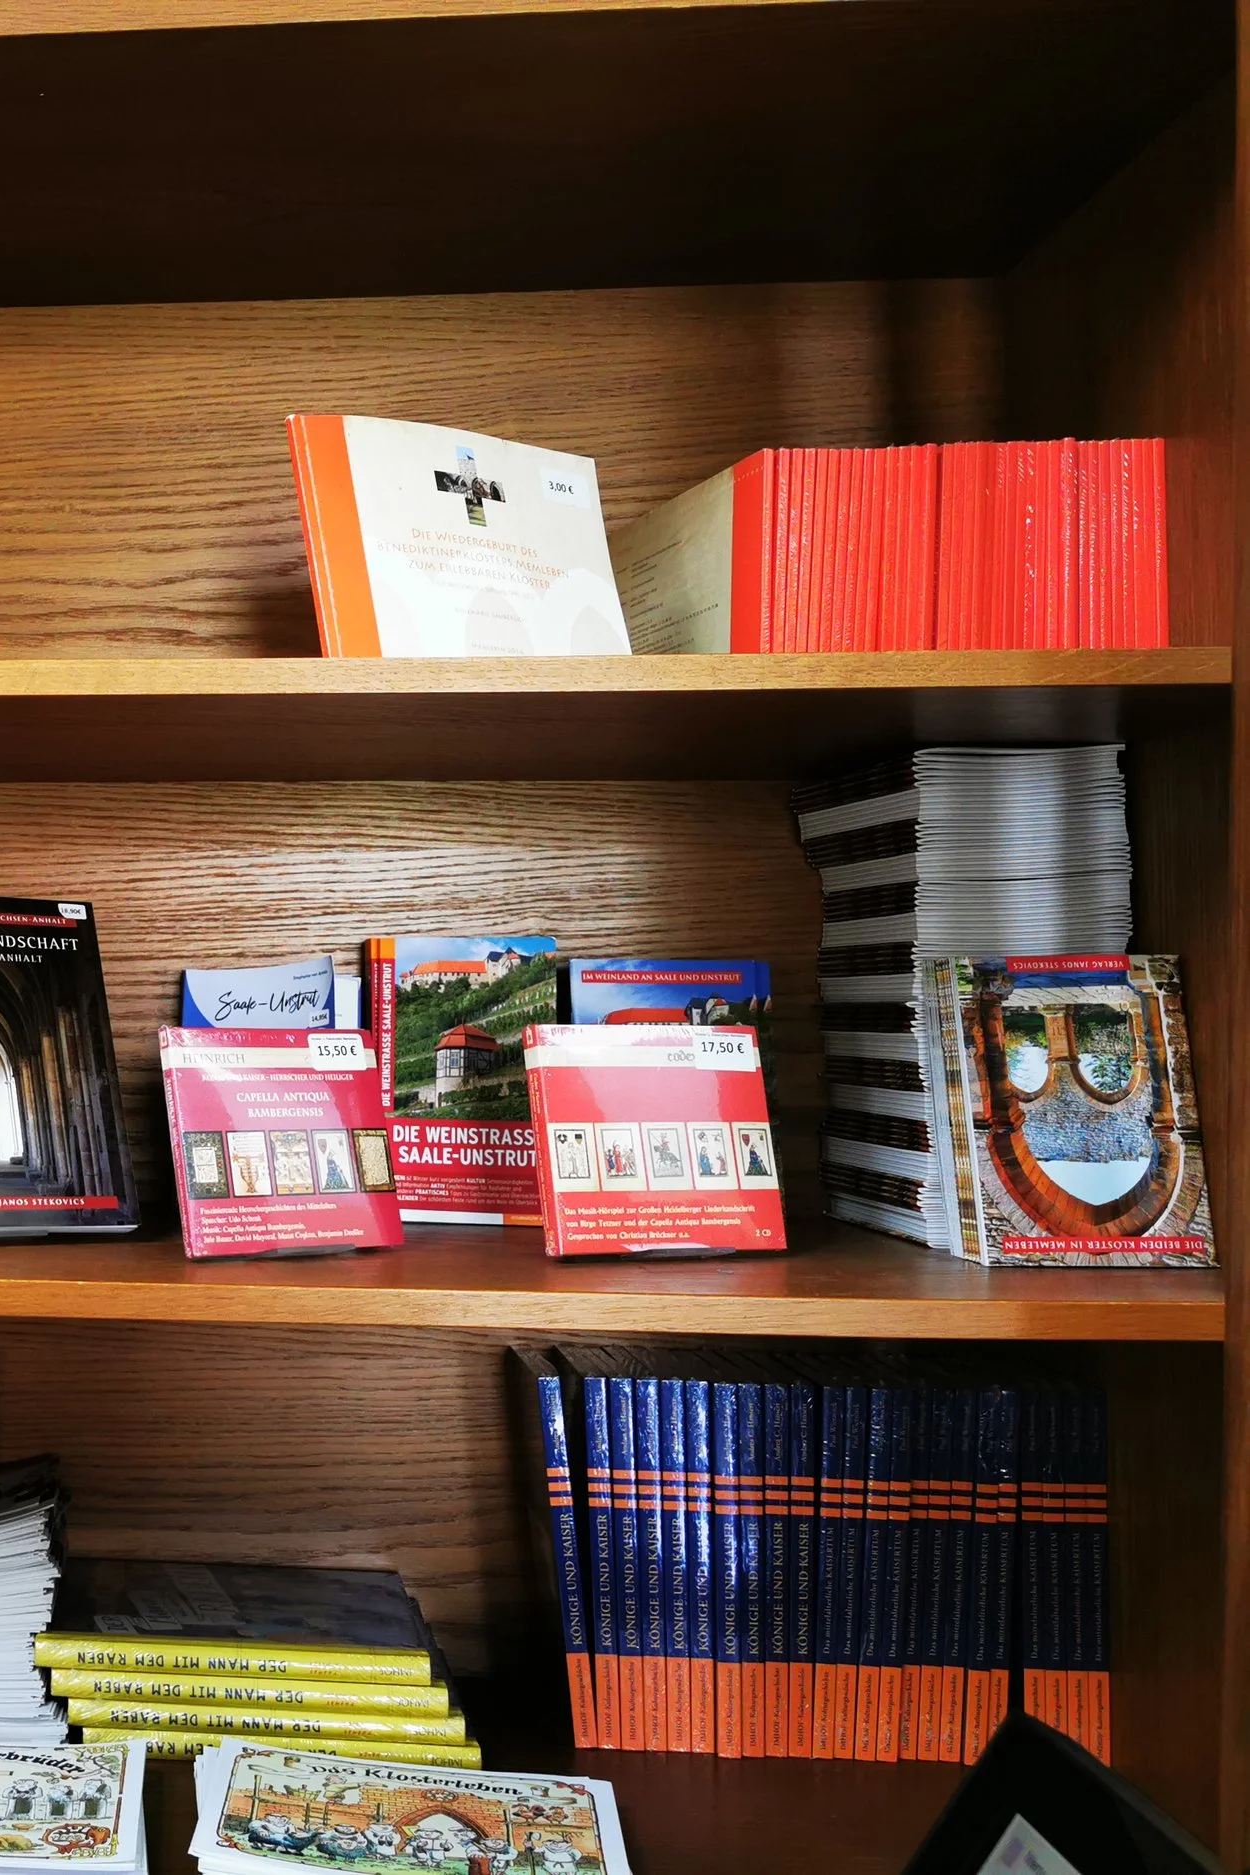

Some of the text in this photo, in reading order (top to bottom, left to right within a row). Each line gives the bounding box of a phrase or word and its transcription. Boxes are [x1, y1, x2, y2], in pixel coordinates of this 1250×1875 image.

[548, 480, 574, 495] 3,00 €
[411, 528, 538, 558] DIE WIEDERGEBURT DES
[409, 560, 435, 572] ZUM
[510, 572, 550, 590] KLOSTER
[515, 559, 569, 579] MEMLEBEN
[1012, 960, 1124, 969] VERLAG JANOS STEKOVICS
[582, 972, 594, 981] IM
[595, 973, 639, 981] WEINLAND
[381, 962, 392, 1107] DIE WEINSTRASSE SAALE-UNSTRUT
[317, 1045, 357, 1058] 15,50 €
[701, 1042, 745, 1055] 17,50 €
[236, 1091, 330, 1103] CAPELLA ANTIQUA
[247, 1107, 325, 1118] BAMBERGENSIS
[392, 1124, 420, 1143] DIE
[398, 1145, 537, 1167] SAALE-UNSTRUT
[31, 1198, 85, 1206] STEKOVICS
[1004, 1241, 1203, 1250] DIE BEIDEN KLÖSTER IN MEMLEBEN
[559, 1513, 583, 1645] KÖNIGE UND KAISER
[596, 1514, 613, 1646] KÖNIGE UND KAISER
[77, 1652, 287, 1673] DER MANN MIT DEM RABEN
[311, 1765, 523, 1796] Das Klosterleben
